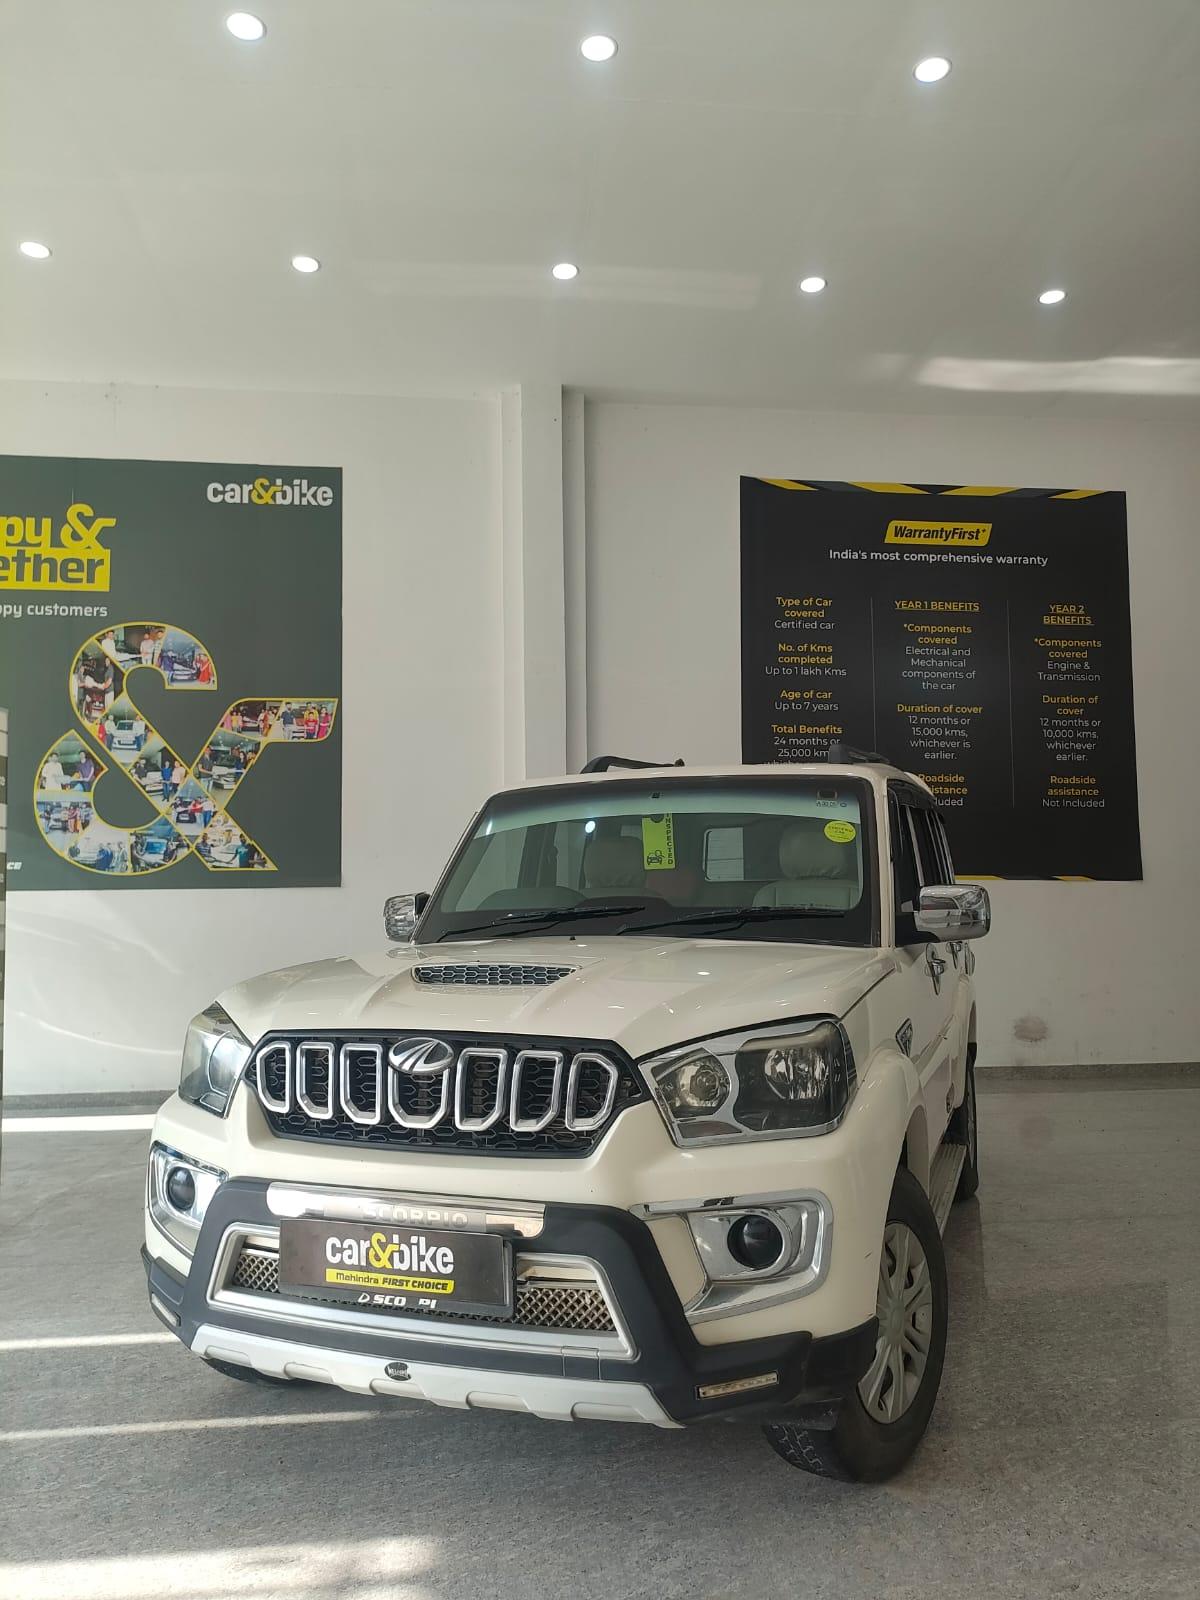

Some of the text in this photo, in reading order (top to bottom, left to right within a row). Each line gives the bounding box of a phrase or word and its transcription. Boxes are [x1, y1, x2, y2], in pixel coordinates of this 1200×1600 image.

[207, 478, 333, 506] car&bike
[60, 503, 116, 550] &
[829, 549, 1048, 567] India's most comprehensive warranty
[776, 596, 833, 607] Type of Car
[895, 600, 980, 611] YEAR 1 BENEFITS
[0, 603, 108, 618] py customers
[784, 609, 825, 618] covered
[1049, 604, 1085, 614] YEAR 2
[774, 620, 835, 630] Certified car
[1043, 615, 1092, 625] BENEFITS
[918, 636, 957, 644] covered
[778, 643, 833, 653] No. of Kms
[905, 646, 971, 656] Electrical and
[1048, 650, 1088, 658] covered
[778, 655, 833, 665] completed
[911, 658, 966, 667] Mechanical
[765, 666, 847, 676] Up to 1 lakh Kms
[1047, 661, 1090, 671] Engine &
[902, 670, 976, 679] components of
[1038, 671, 1100, 681] Transmission
[922, 681, 938, 690] the
[780, 690, 801, 700] Age
[803, 690, 813, 699] of
[1042, 695, 1099, 704] Duration of
[775, 701, 839, 712] Up to 7 years
[897, 704, 940, 713] Duration
[943, 704, 953, 713] of
[908, 715, 918, 724] 12
[920, 716, 958, 725] months
[1040, 718, 1049, 727] 12
[1051, 718, 1089, 727] months
[771, 724, 843, 734] Total Benefits
[945, 727, 968, 738] kms,
[1042, 729, 1074, 739] 10,000
[774, 737, 786, 745] 24
[789, 737, 828, 745] months
[910, 739, 971, 748] whichever is
[1046, 741, 1096, 750] whichever
[778, 749, 829, 758] 25,000 km
[925, 750, 957, 760] earlier.
[1056, 752, 1088, 761] earlier.
[918, 774, 965, 783] Roadside
[1050, 775, 1096, 784] Roadside
[932, 785, 968, 795] istance
[1048, 787, 1099, 796] assistance
[935, 797, 963, 806] luded
[1042, 799, 1105, 808] Not Included
[326, 1232, 454, 1275] car&bike
[336, 1272, 449, 1291] Mahindra FIRST CHOICE
